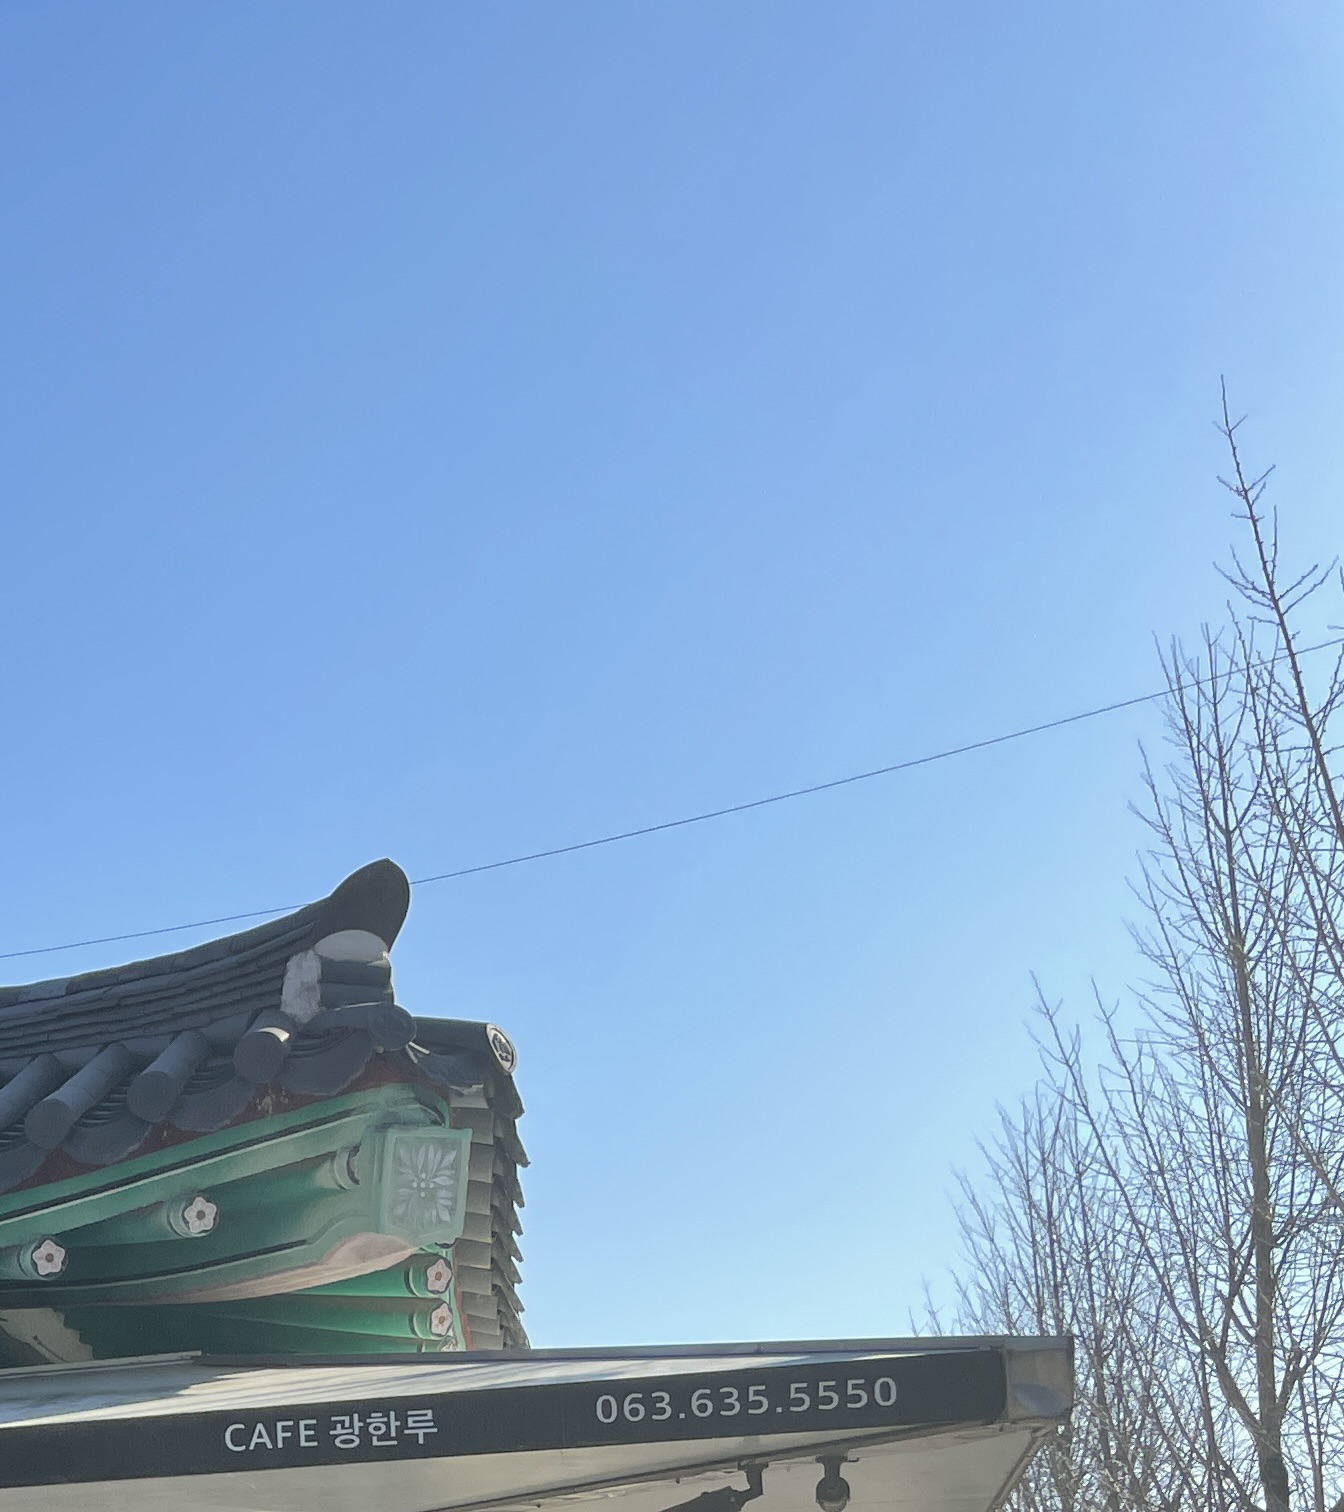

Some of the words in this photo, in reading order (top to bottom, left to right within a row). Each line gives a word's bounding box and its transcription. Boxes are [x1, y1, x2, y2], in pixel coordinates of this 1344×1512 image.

[595, 1377, 898, 1424] 063.635.5550
[224, 1418, 319, 1452] CAFE
[328, 1409, 439, 1449] 광한루
